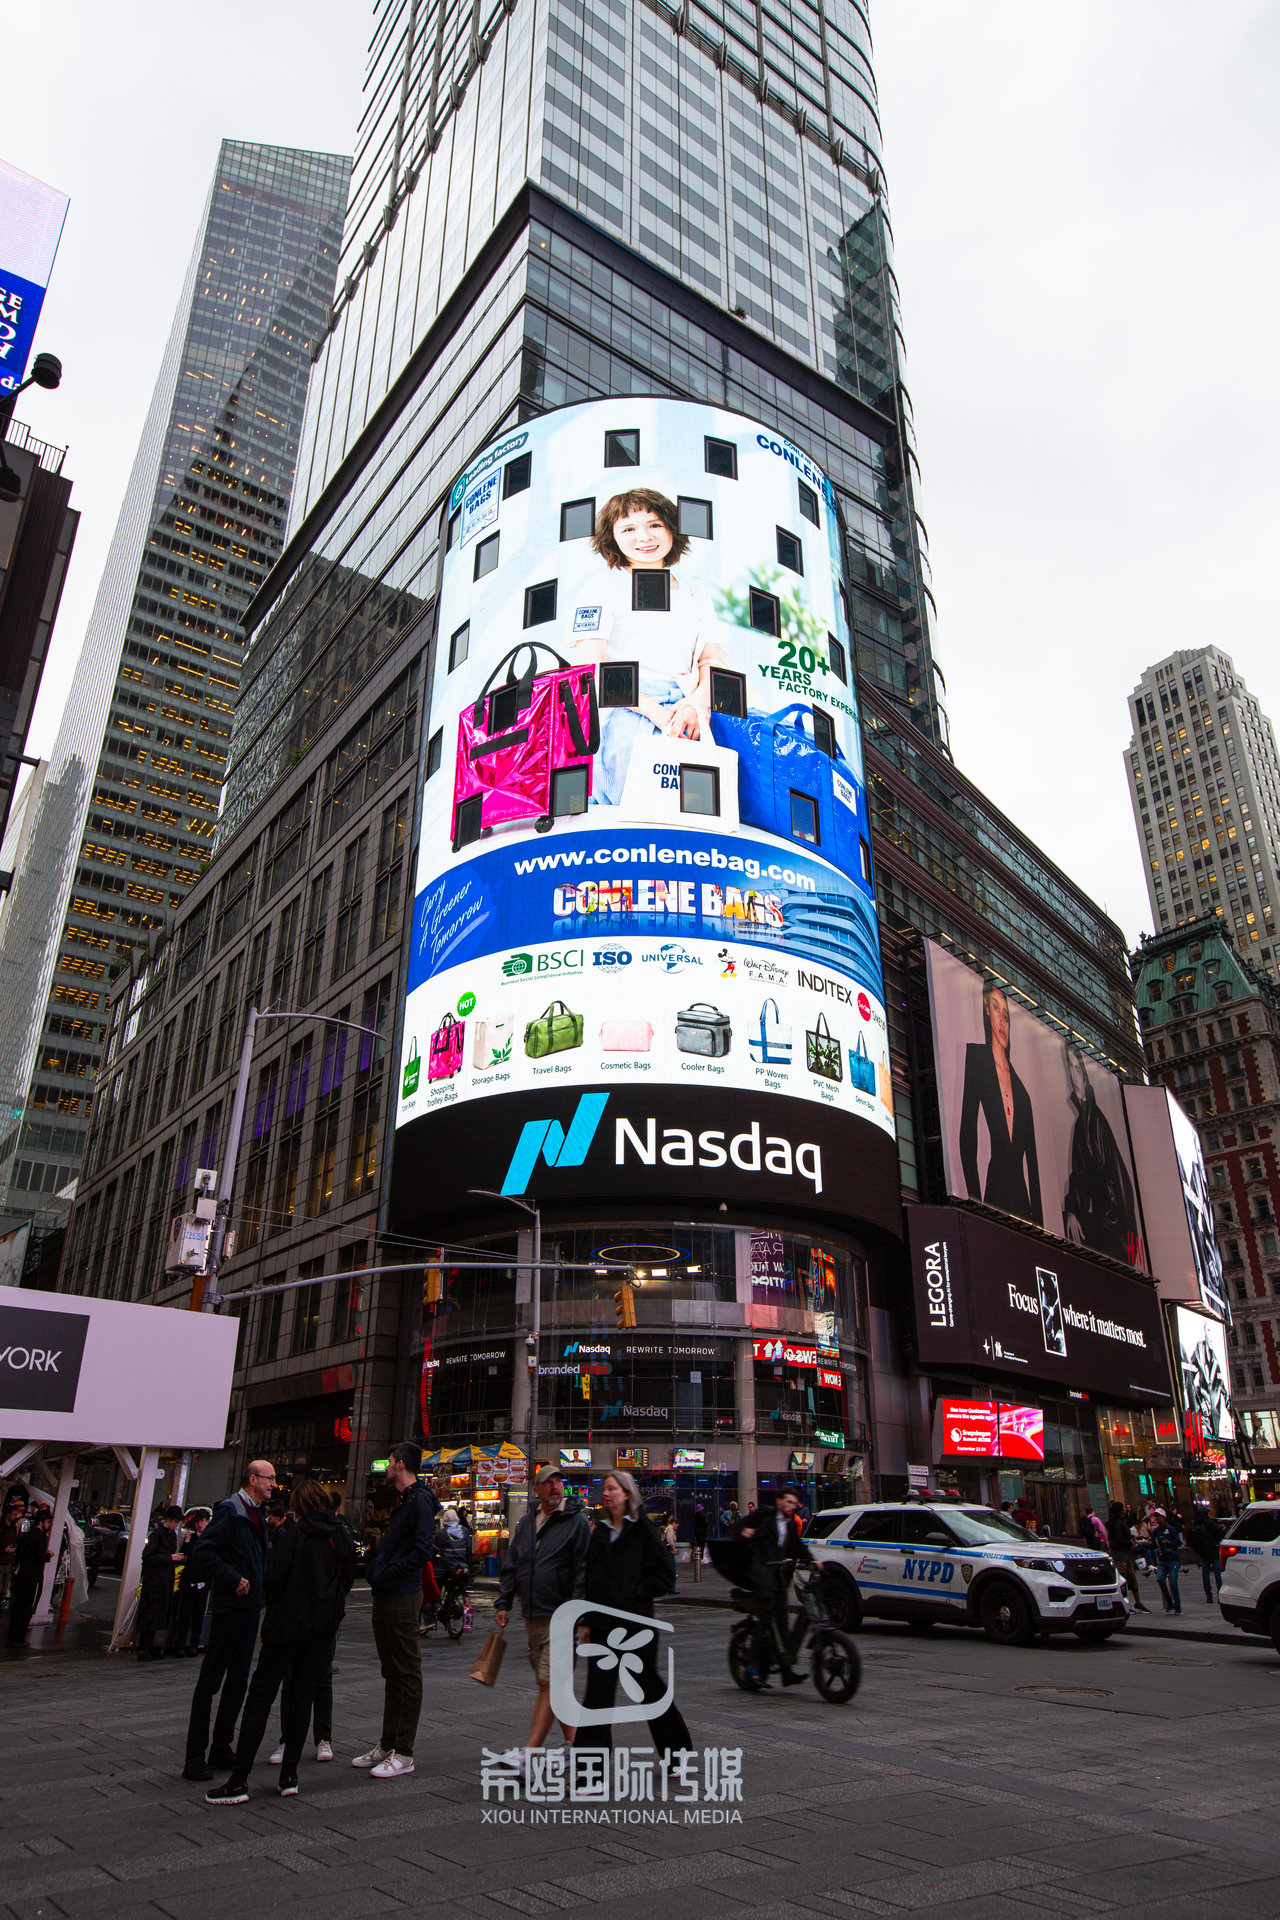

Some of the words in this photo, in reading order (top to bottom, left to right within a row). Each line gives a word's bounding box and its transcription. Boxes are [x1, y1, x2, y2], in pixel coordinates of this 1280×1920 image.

[494, 436, 526, 458] factory
[756, 434, 828, 498] CONLENE
[465, 475, 498, 509] CONLENE
[469, 490, 492, 515] BAGS
[777, 641, 831, 677] 20+
[758, 664, 812, 686] YEARS
[778, 681, 828, 703] FACTORY
[515, 843, 816, 892] www.conlenebag.com
[431, 880, 473, 935] Greener
[553, 879, 697, 918] CONLENE
[700, 882, 784, 929] BAGS
[430, 895, 484, 965] Tomorrow
[537, 949, 584, 972] BSCI
[592, 951, 632, 967] ISO
[642, 953, 704, 966] UNIVERSAL
[797, 969, 853, 1007] INDITEX
[459, 998, 474, 1011] HOT
[533, 1066, 553, 1075] Travel
[555, 1064, 572, 1074] Bags
[600, 1062, 632, 1070] Cosmetic
[633, 1062, 651, 1071] Bags
[681, 1062, 705, 1071] Cooler
[707, 1064, 725, 1075] Bags
[755, 1067, 765, 1076] PP
[766, 1069, 789, 1080] Woven
[472, 1074, 494, 1086] Storage
[495, 1071, 511, 1082] Bags
[764, 1078, 781, 1089] Bags
[813, 1079, 825, 1088] PVC
[825, 1081, 840, 1093] Mesh
[427, 1096, 443, 1107] Trolley
[444, 1092, 458, 1103] Bags
[430, 1083, 455, 1097] Shopping
[820, 1090, 835, 1101] Bags
[615, 1117, 823, 1195] Nasdaq
[924, 1241, 947, 1328] LEGORA
[1007, 1282, 1039, 1315] Focus
[1062, 1303, 1089, 1331] where
[1089, 1310, 1097, 1334] it
[1096, 1318, 1127, 1343] matters
[1125, 1328, 1147, 1348] most.
[446, 1354, 468, 1366] REWRITE
[470, 1350, 507, 1363] TOMORROW
[579, 1344, 611, 1355] Nasdaq
[626, 1346, 664, 1354] REWRITE
[667, 1346, 716, 1356] TOMORROW
[622, 1404, 669, 1420] Nasdaq
[982, 1552, 1004, 1560] POLICE
[902, 1558, 955, 1584] NYPD
